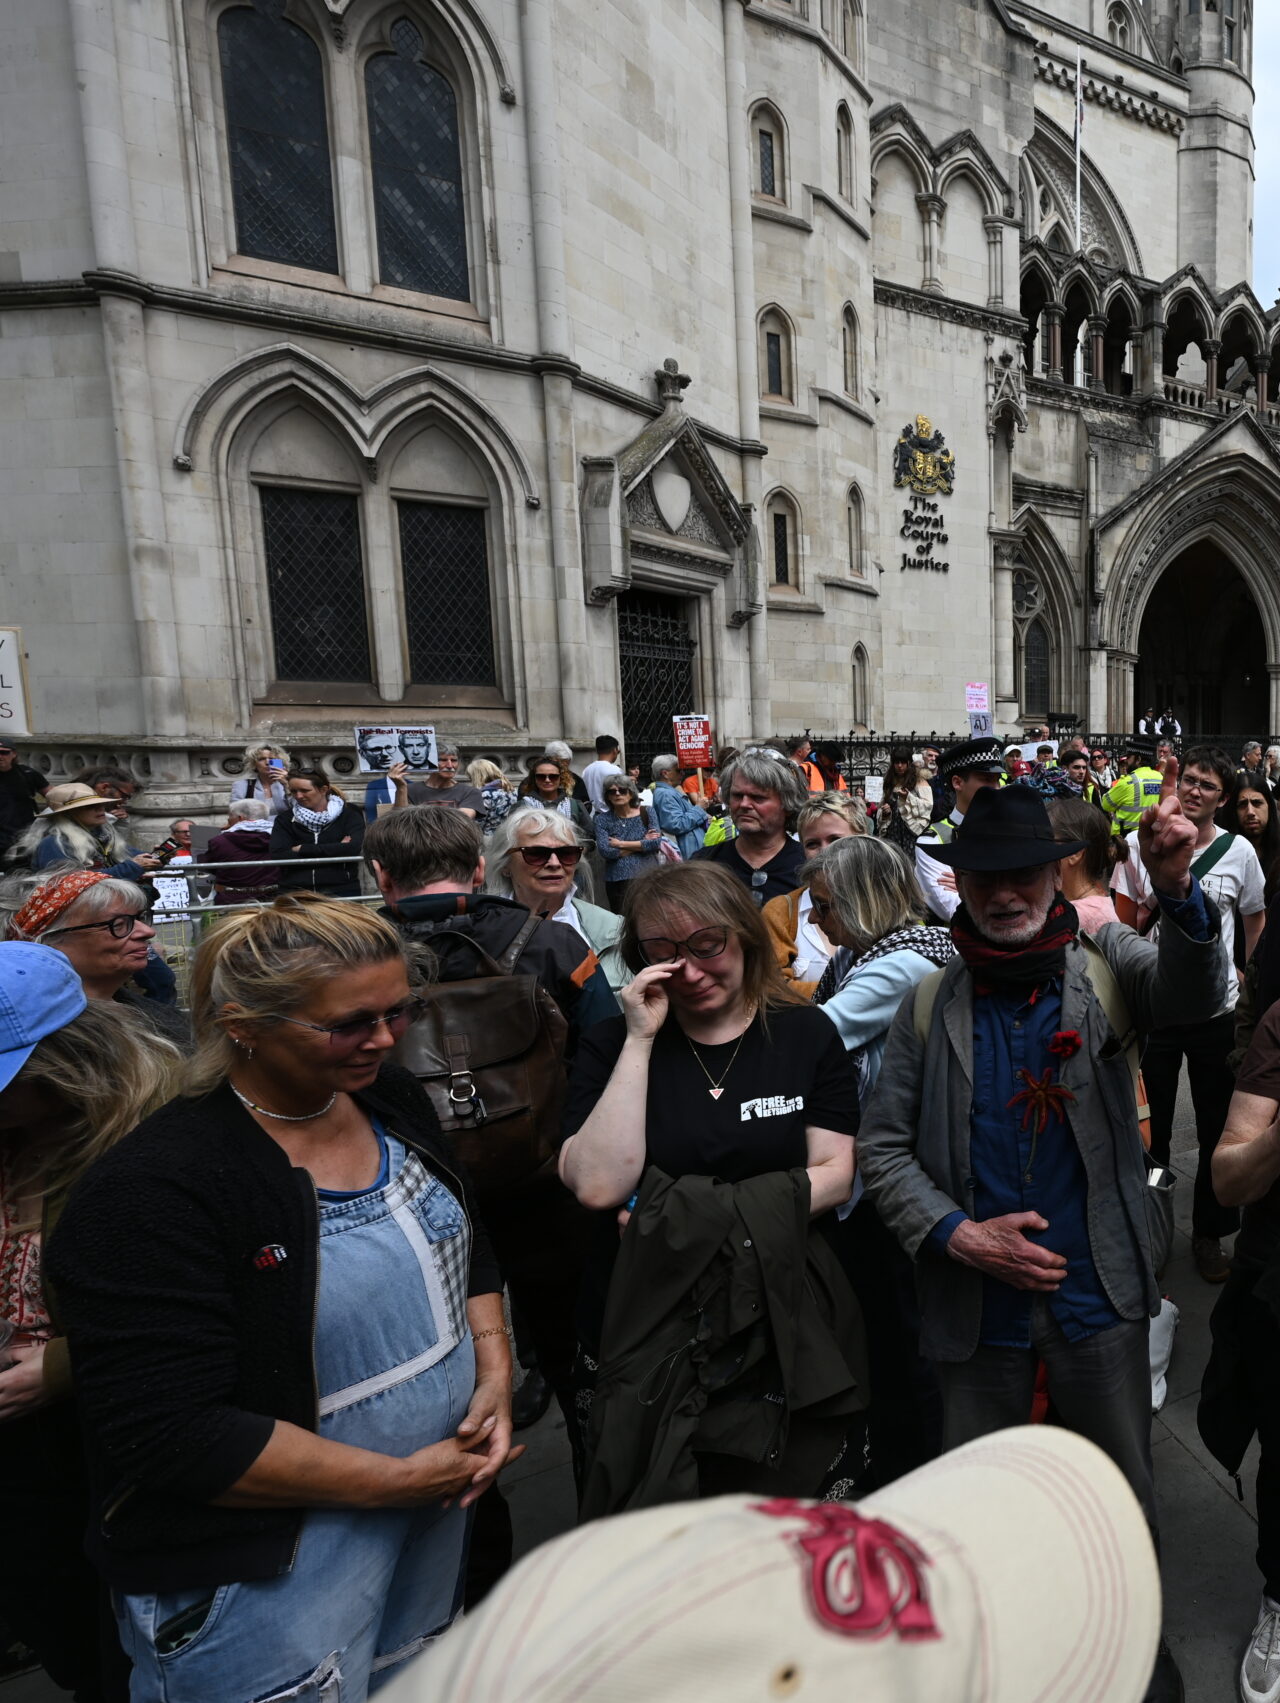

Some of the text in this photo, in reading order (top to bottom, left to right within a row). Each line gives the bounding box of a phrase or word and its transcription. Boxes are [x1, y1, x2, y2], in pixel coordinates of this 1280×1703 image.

[909, 495, 938, 512] The
[902, 509, 945, 529] Royal
[900, 524, 949, 544] Courts
[915, 542, 933, 555] of
[900, 553, 950, 573] Justice
[679, 742, 705, 750] GENOCIDE
[762, 1095, 786, 1110] FREE
[795, 1095, 804, 1111] 3
